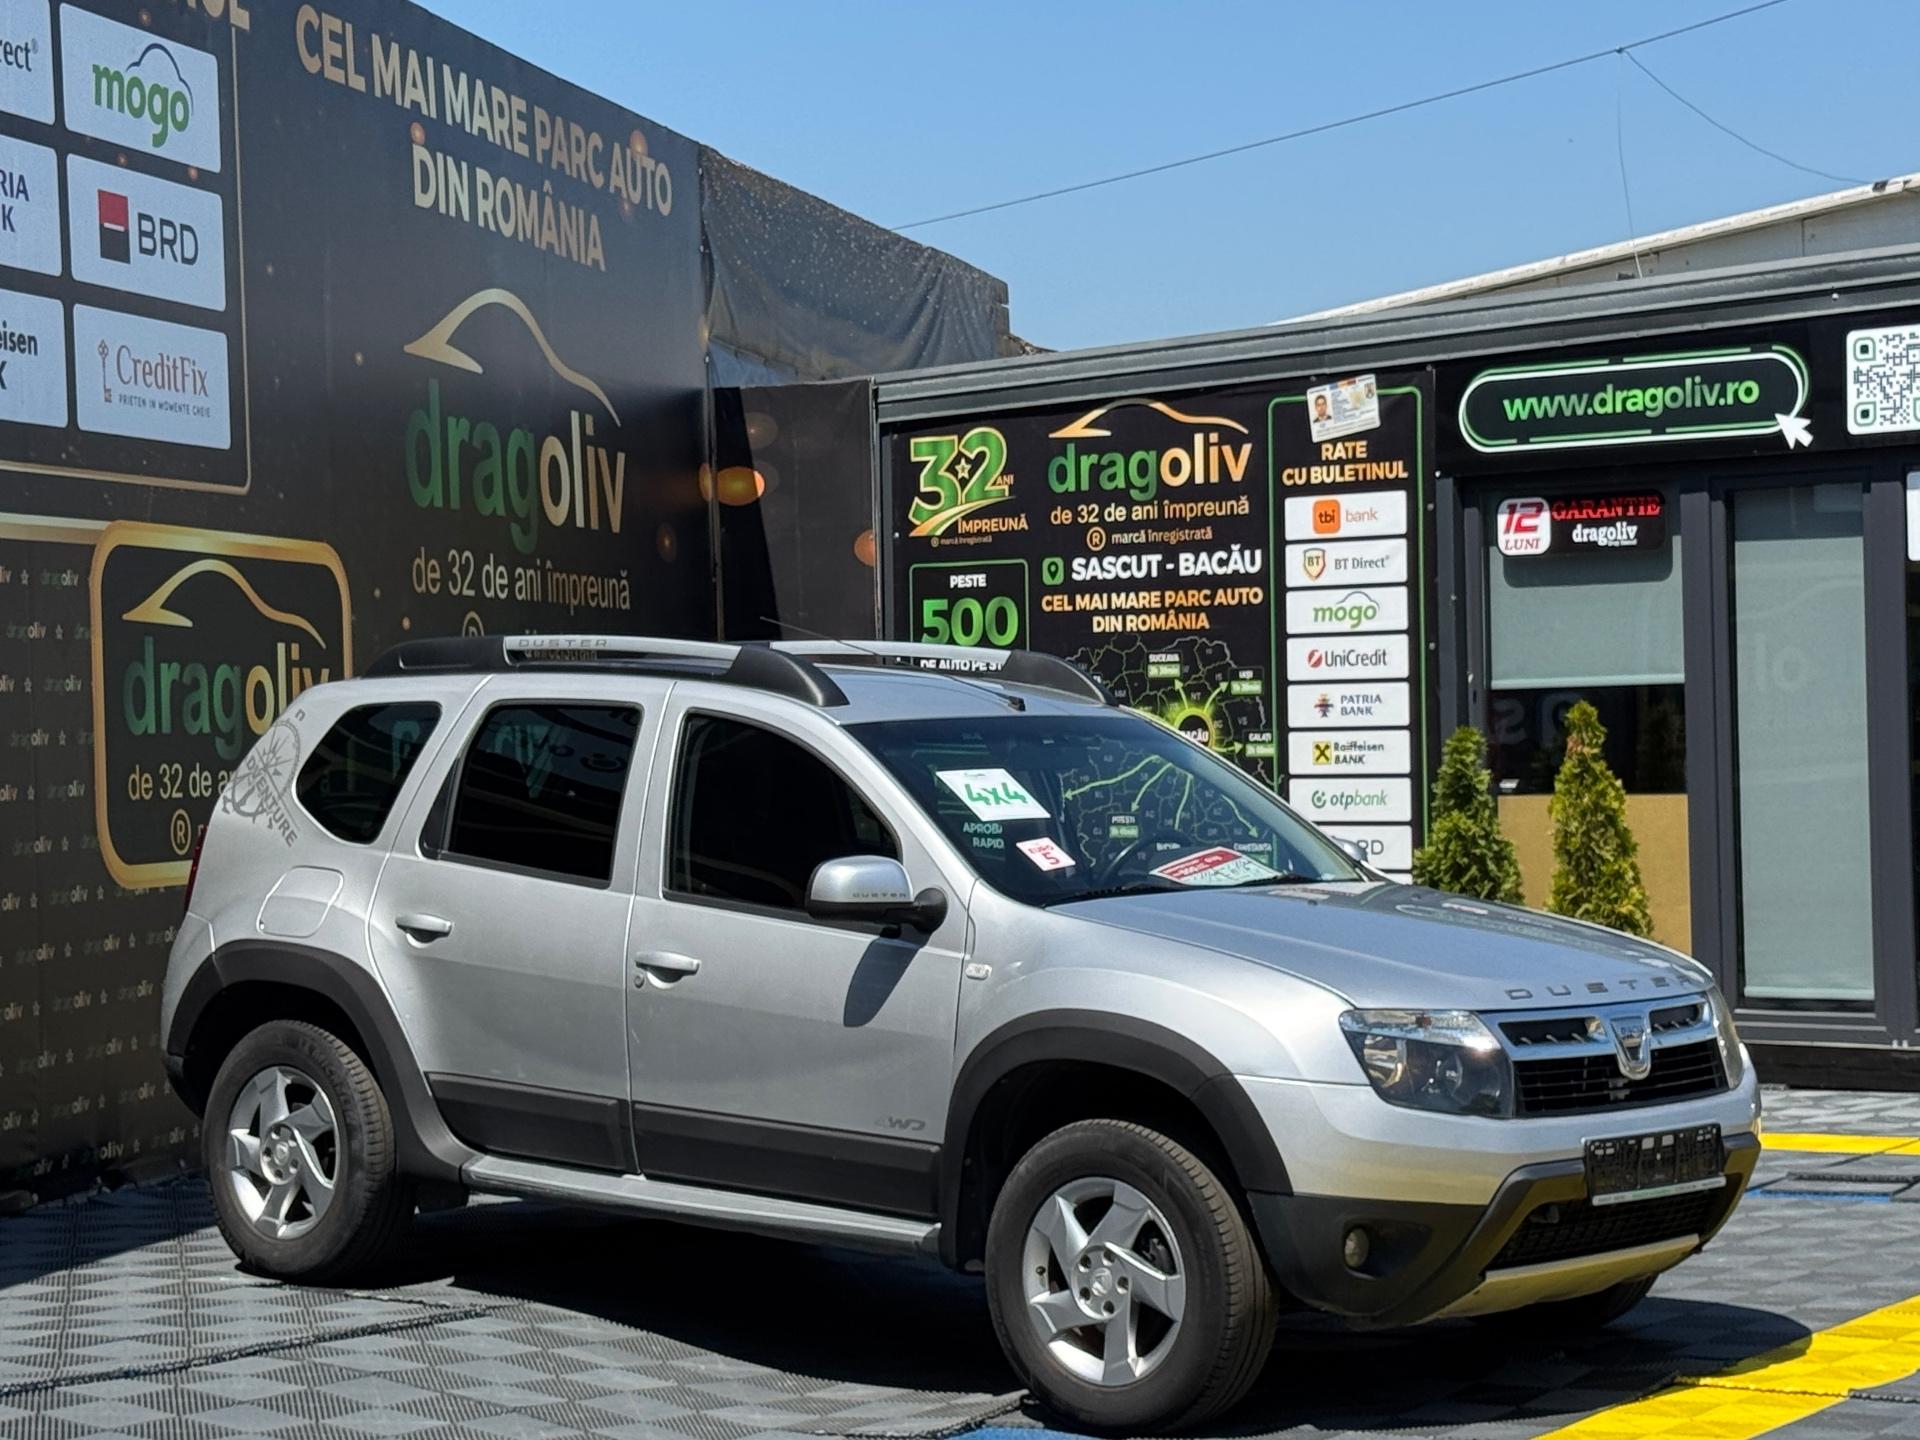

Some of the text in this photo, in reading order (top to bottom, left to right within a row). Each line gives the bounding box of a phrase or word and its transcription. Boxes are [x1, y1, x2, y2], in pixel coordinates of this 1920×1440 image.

[92, 64, 190, 148] mogo
[296, 4, 672, 217] CEL MAI MARE PARC AUTO
[412, 143, 606, 272] DIN ROMÂNIA
[138, 212, 199, 266] BRD
[116, 344, 209, 398] CreditFix
[1502, 375, 1761, 421] www.dragoliv.ro
[1321, 440, 1368, 461] RATE
[405, 379, 626, 554] dragoliv
[908, 426, 1008, 525] 32
[1048, 432, 1253, 500] dragoliv
[1282, 460, 1409, 486] CU BULETINUL
[1050, 495, 1250, 525] de 32 de ani împreună
[1318, 508, 1379, 524] tbi bank
[1503, 502, 1544, 535] 12
[1551, 496, 1661, 521] GARANTIE
[957, 513, 1029, 535] ÎMPREUNĂ
[1111, 529, 1146, 545] marcă
[1148, 526, 1214, 545] înregistrată
[1572, 520, 1639, 547] dragoliv
[1504, 538, 1541, 551] LUNI
[1071, 553, 1163, 582] SASCUT
[1178, 543, 1263, 577] BACĂU
[1307, 554, 1321, 567] BT
[1334, 557, 1349, 570] BT
[412, 547, 631, 616] de 32 de ani împreună
[949, 573, 988, 589] PESTE
[1041, 587, 1264, 613] CEL MAI MARE PARC AUTO
[921, 596, 1019, 646] 500
[1092, 610, 1210, 633] DIN ROMÂNIA
[1313, 604, 1377, 629] mogo
[518, 639, 608, 648] DUSTER
[939, 658, 970, 671] AUTO
[1325, 648, 1388, 668] UniCredit
[123, 635, 330, 761] dragoli
[1340, 694, 1382, 705] PATRIA
[1340, 706, 1374, 716] BANK
[1333, 741, 1385, 752] Raiffeisen
[1334, 754, 1366, 765] BANK
[128, 765, 153, 800] de
[159, 763, 183, 799] 32
[189, 763, 212, 797] de
[1330, 789, 1388, 810] otpbank
[1041, 852, 1060, 865] 5
[1504, 974, 1698, 1001] DUSTER
